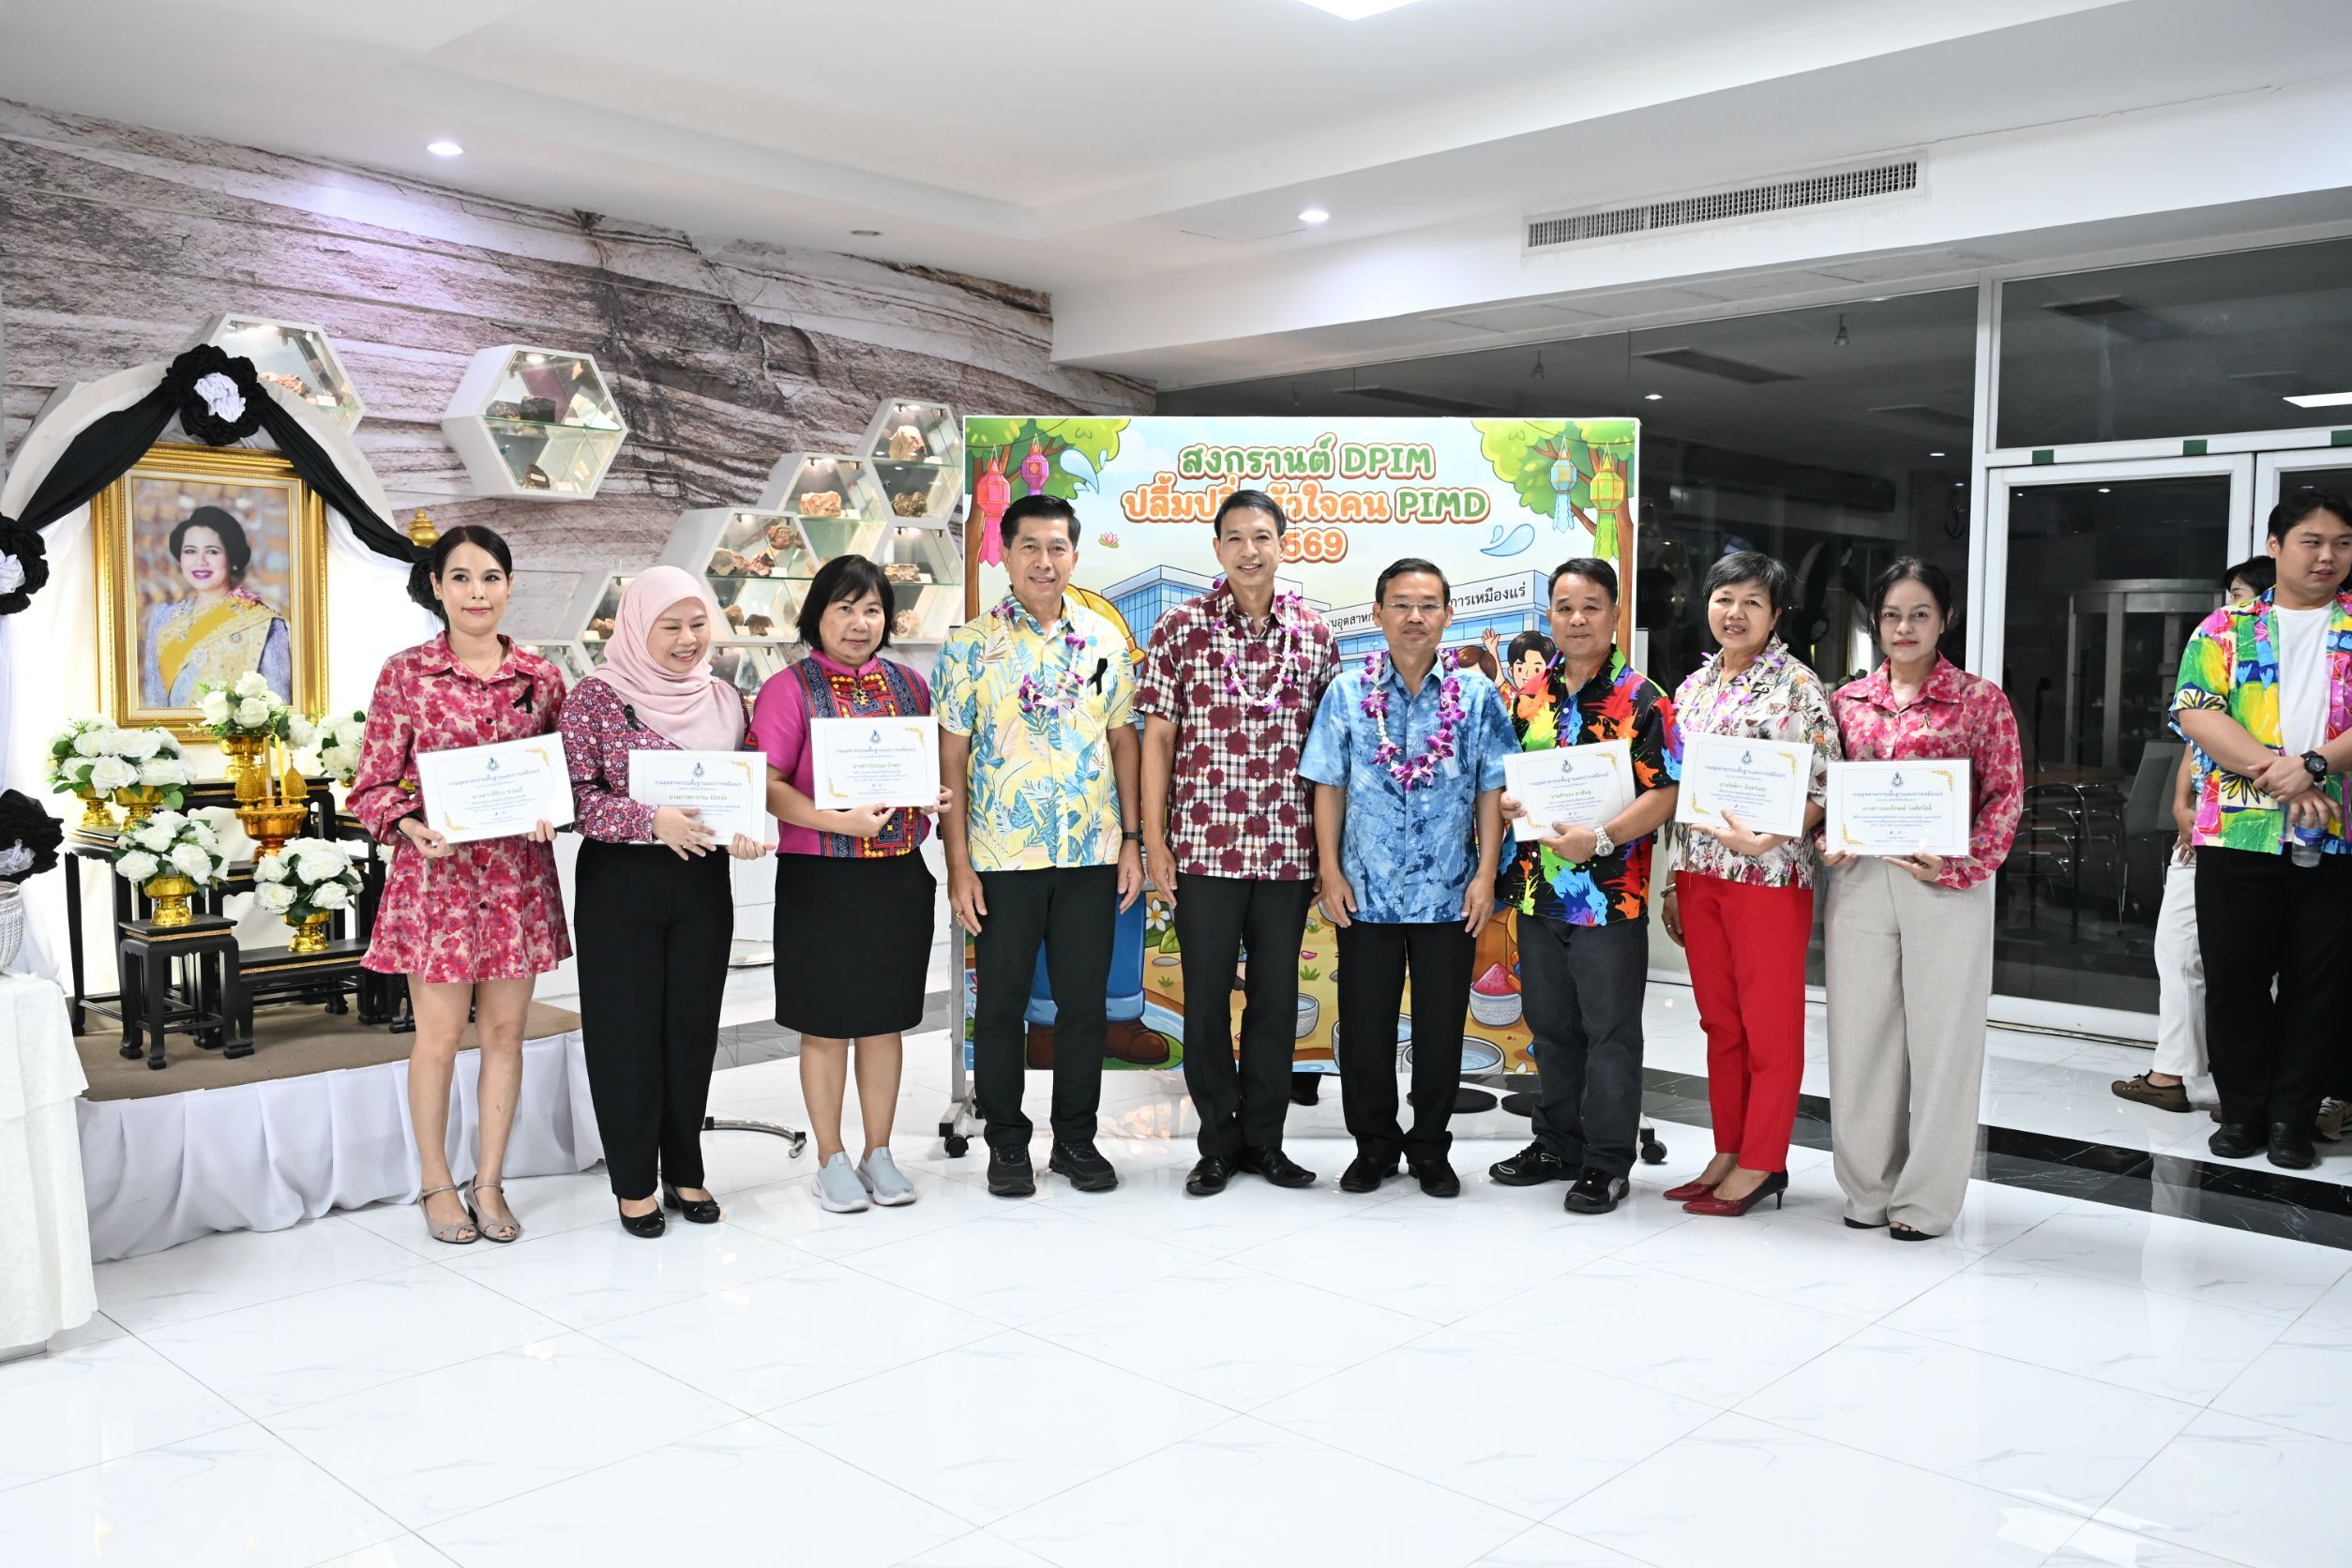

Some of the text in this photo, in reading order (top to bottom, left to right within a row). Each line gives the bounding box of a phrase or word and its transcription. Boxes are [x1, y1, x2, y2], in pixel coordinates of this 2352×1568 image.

[1180, 434, 1433, 475] สงกรานต์ DPIM
[1397, 490, 1487, 520] PIMD
[1285, 531, 1344, 560] 569
